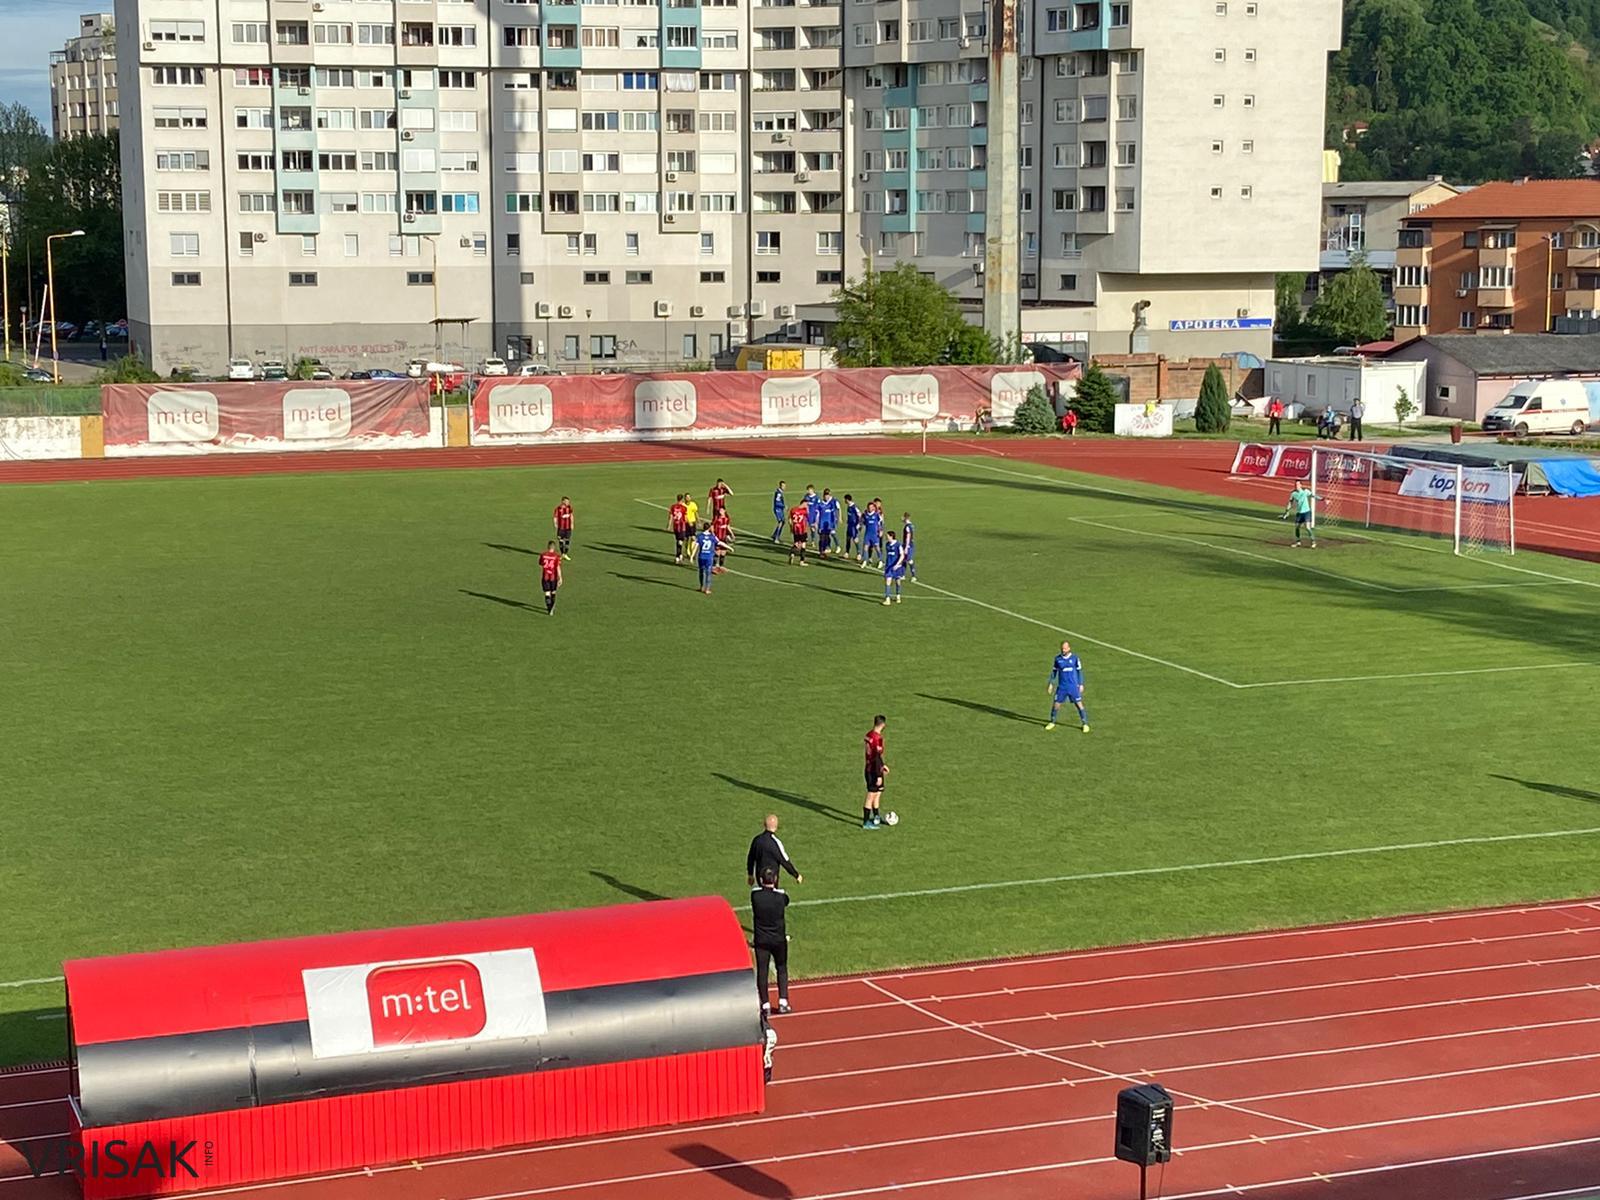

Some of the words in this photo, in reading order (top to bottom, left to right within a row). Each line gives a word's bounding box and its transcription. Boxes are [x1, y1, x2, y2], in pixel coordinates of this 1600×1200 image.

[1173, 319, 1240, 330] APOTEKA
[643, 396, 688, 412] m:tel
[768, 390, 813, 408] m:tel
[888, 388, 931, 405] m:tel
[157, 406, 209, 424] m:tel
[291, 402, 343, 421] m:tel
[497, 398, 544, 417] m:tel
[1243, 455, 1268, 466] m:tel
[1281, 456, 1309, 470] m:tel
[382, 979, 472, 1018] m:tel
